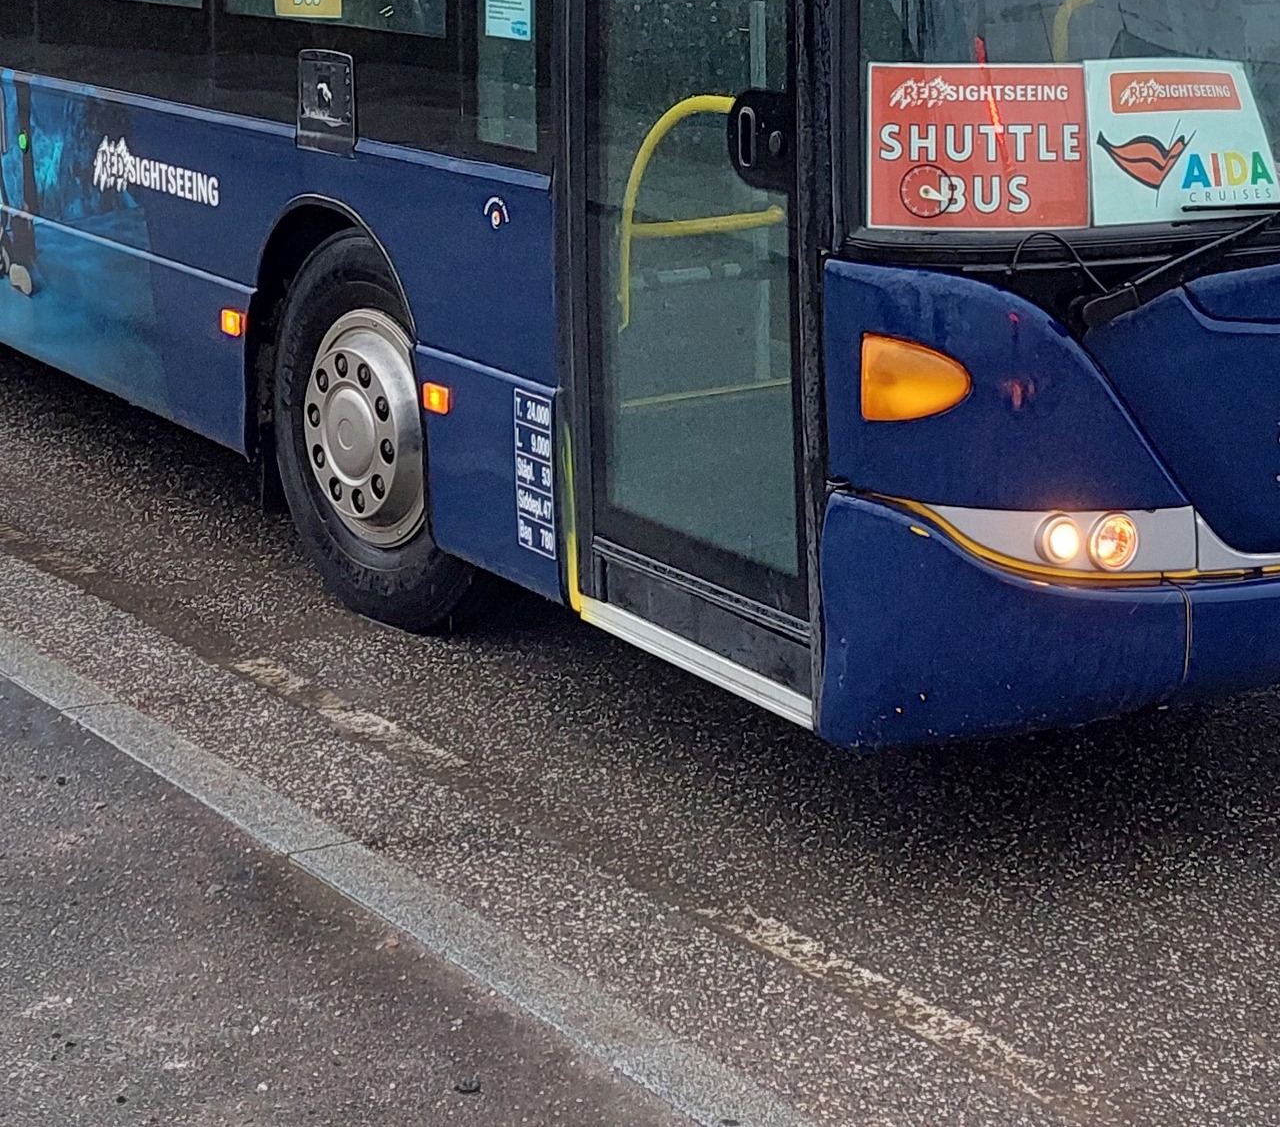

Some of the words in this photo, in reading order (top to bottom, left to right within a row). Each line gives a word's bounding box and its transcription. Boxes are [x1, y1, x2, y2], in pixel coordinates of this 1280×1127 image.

[946, 85, 1069, 102] SIGHTSEEING
[1159, 84, 1231, 98] SIGHTSEEING
[879, 122, 1082, 163] SHUTTLE
[128, 155, 220, 207] SIGHTSEEING
[1181, 151, 1274, 189] AIDA
[939, 174, 1031, 214] BUS
[1189, 188, 1272, 203] CRUISES
[526, 400, 550, 426] 24.000
[531, 433, 550, 458] 9.000
[541, 466, 551, 487] 53
[519, 518, 533, 546] Bag
[540, 528, 554, 552] 780
